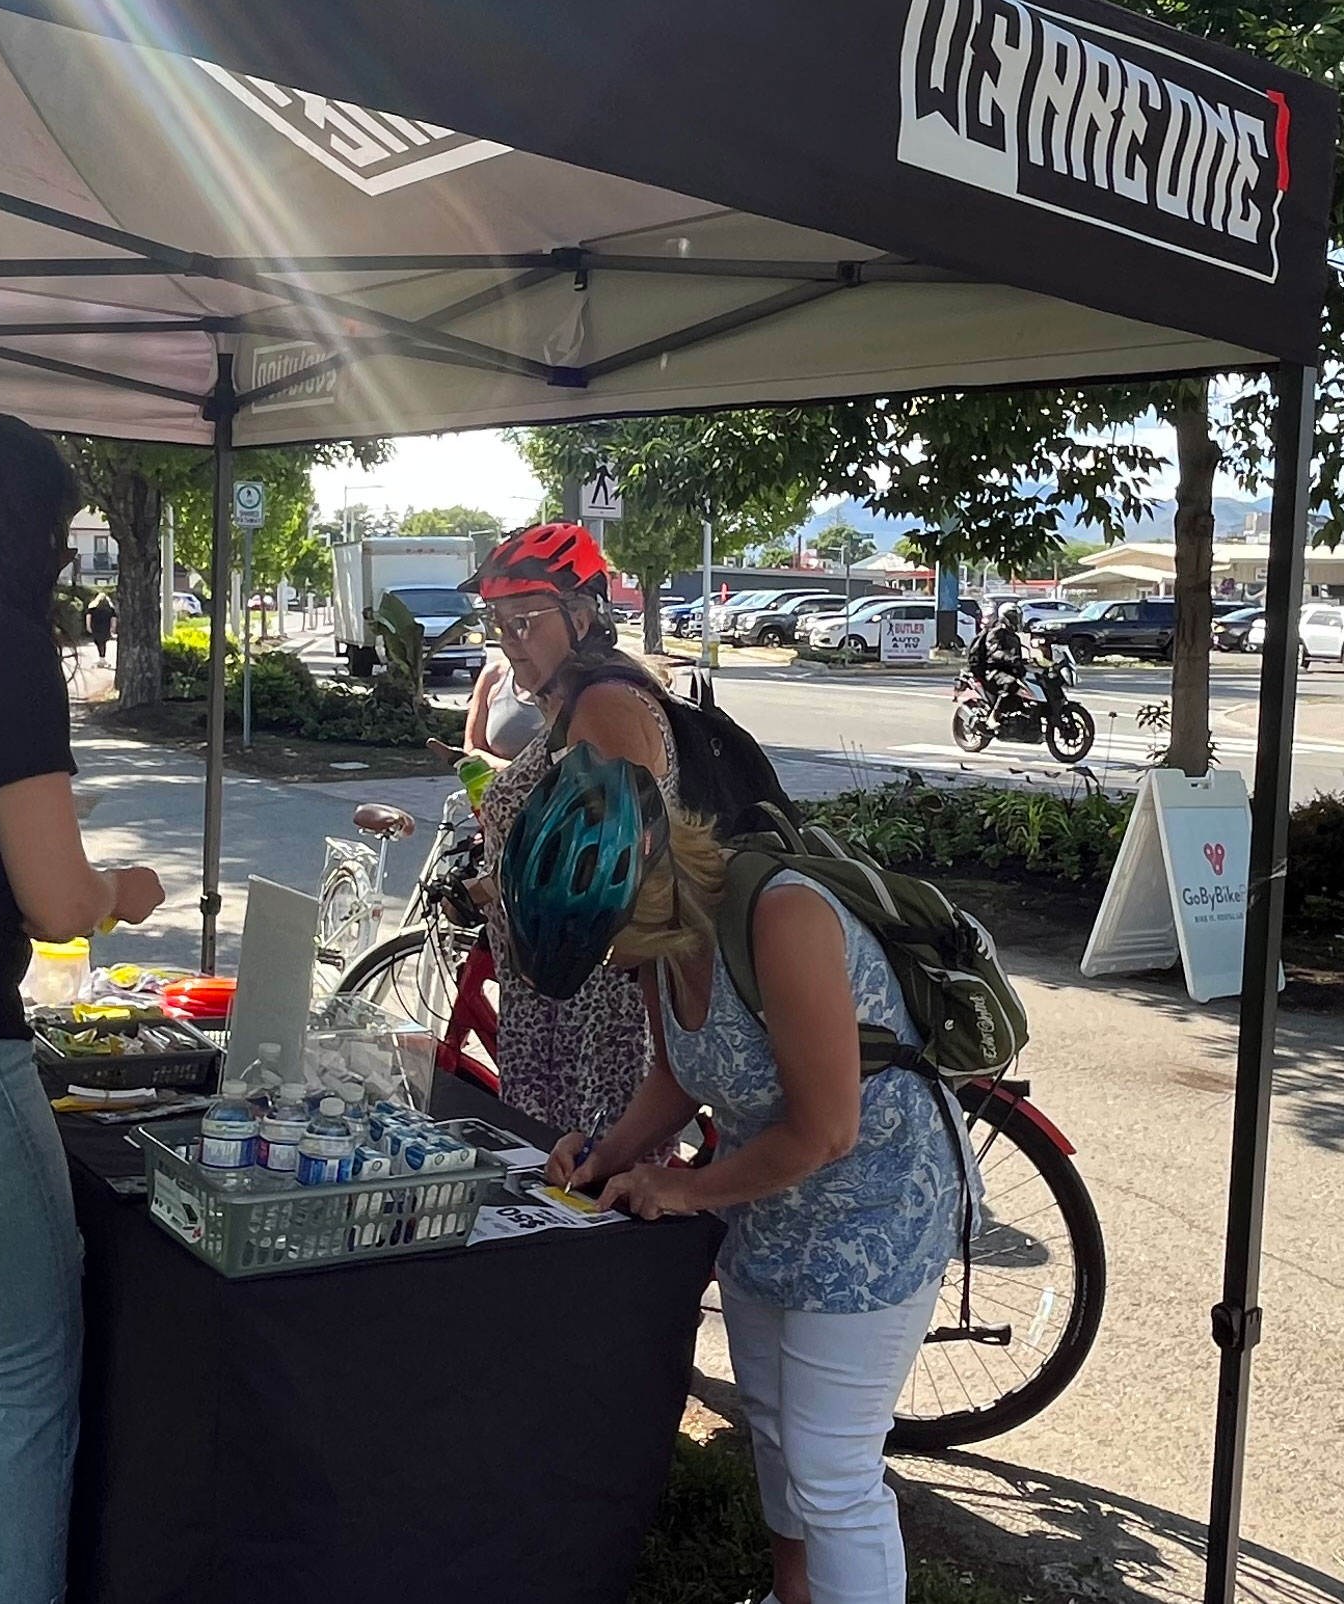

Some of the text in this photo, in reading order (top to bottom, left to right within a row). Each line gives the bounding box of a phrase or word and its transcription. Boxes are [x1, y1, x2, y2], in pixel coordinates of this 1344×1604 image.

[1028, 17, 1162, 205] ARE
[1156, 78, 1269, 245] ONE
[895, 623, 925, 635] BUTLER
[1182, 885, 1242, 912] GoByBike
